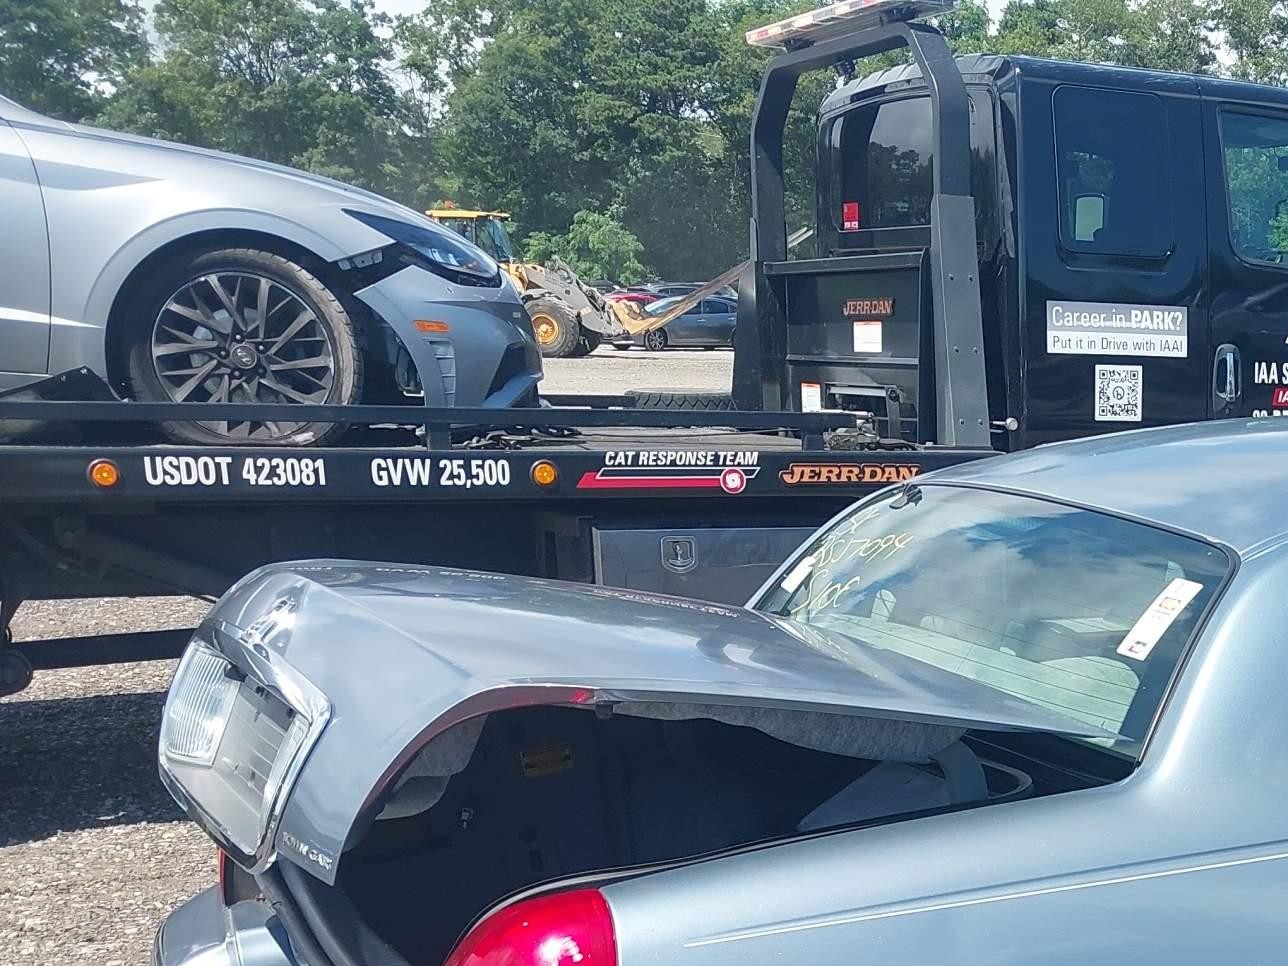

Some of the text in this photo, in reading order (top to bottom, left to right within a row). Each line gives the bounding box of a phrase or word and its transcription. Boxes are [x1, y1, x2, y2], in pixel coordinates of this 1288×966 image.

[1052, 306, 1183, 331] Career in PARK?
[1052, 335, 1183, 353] Put it in Drive with IAAI
[1254, 362, 1278, 384] IAA
[605, 451, 759, 466] CAT RESPONSE TEAM
[143, 456, 326, 486] USDOT 423081
[371, 458, 511, 488] GVW 25,500
[782, 465, 919, 484] JERR-DAN
